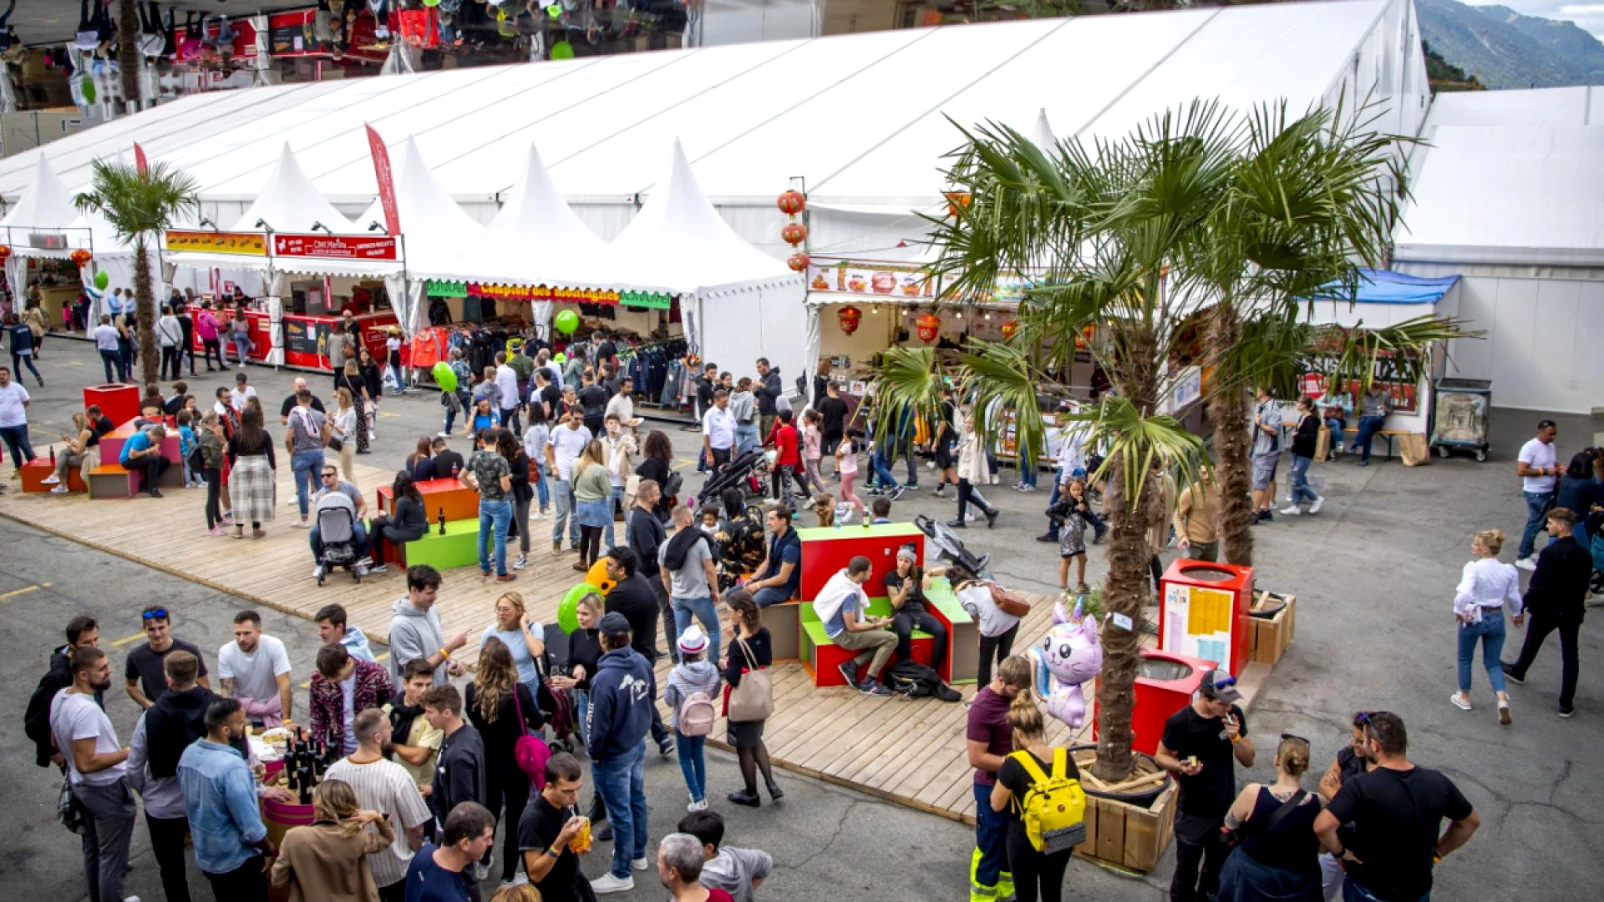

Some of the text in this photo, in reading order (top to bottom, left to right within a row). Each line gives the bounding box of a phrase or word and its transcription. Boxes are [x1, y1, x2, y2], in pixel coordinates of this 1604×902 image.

[481, 282, 529, 298] Comptoir
[532, 284, 551, 297] des
[554, 286, 619, 302] montagnes
